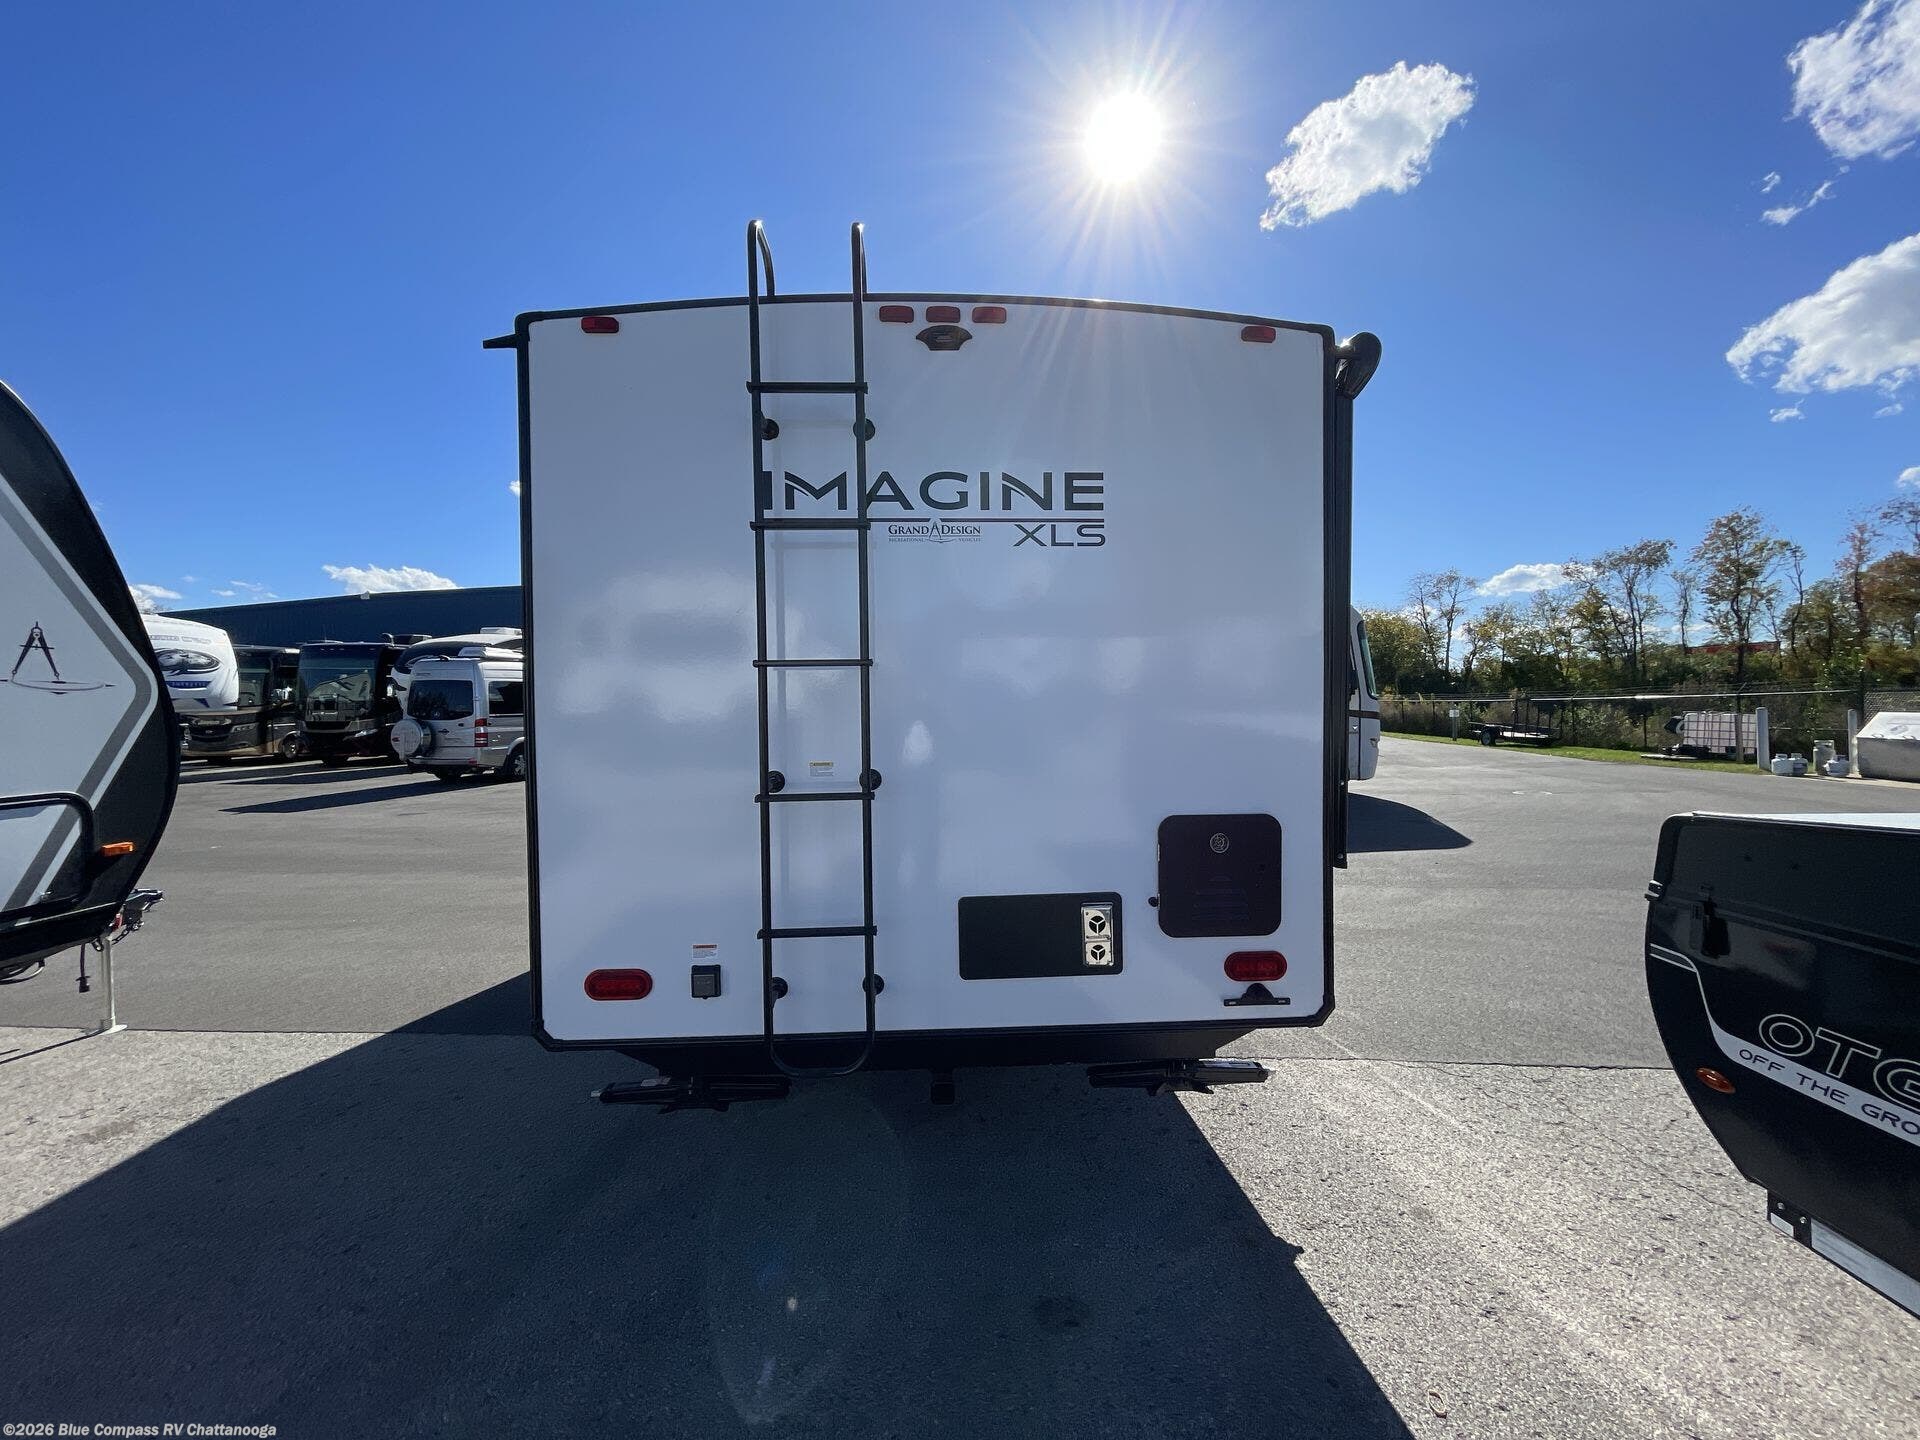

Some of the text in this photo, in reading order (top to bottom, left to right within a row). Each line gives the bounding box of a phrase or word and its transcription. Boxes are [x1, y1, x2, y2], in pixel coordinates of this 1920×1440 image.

[761, 471, 1104, 511] IMAGINE
[888, 525, 981, 535] GRAND DESIGN
[1013, 524, 1106, 547] XLS
[1739, 1049, 1785, 1072] OFF
[1796, 1072, 1850, 1105] THE
[1759, 1014, 1920, 1116] OTG
